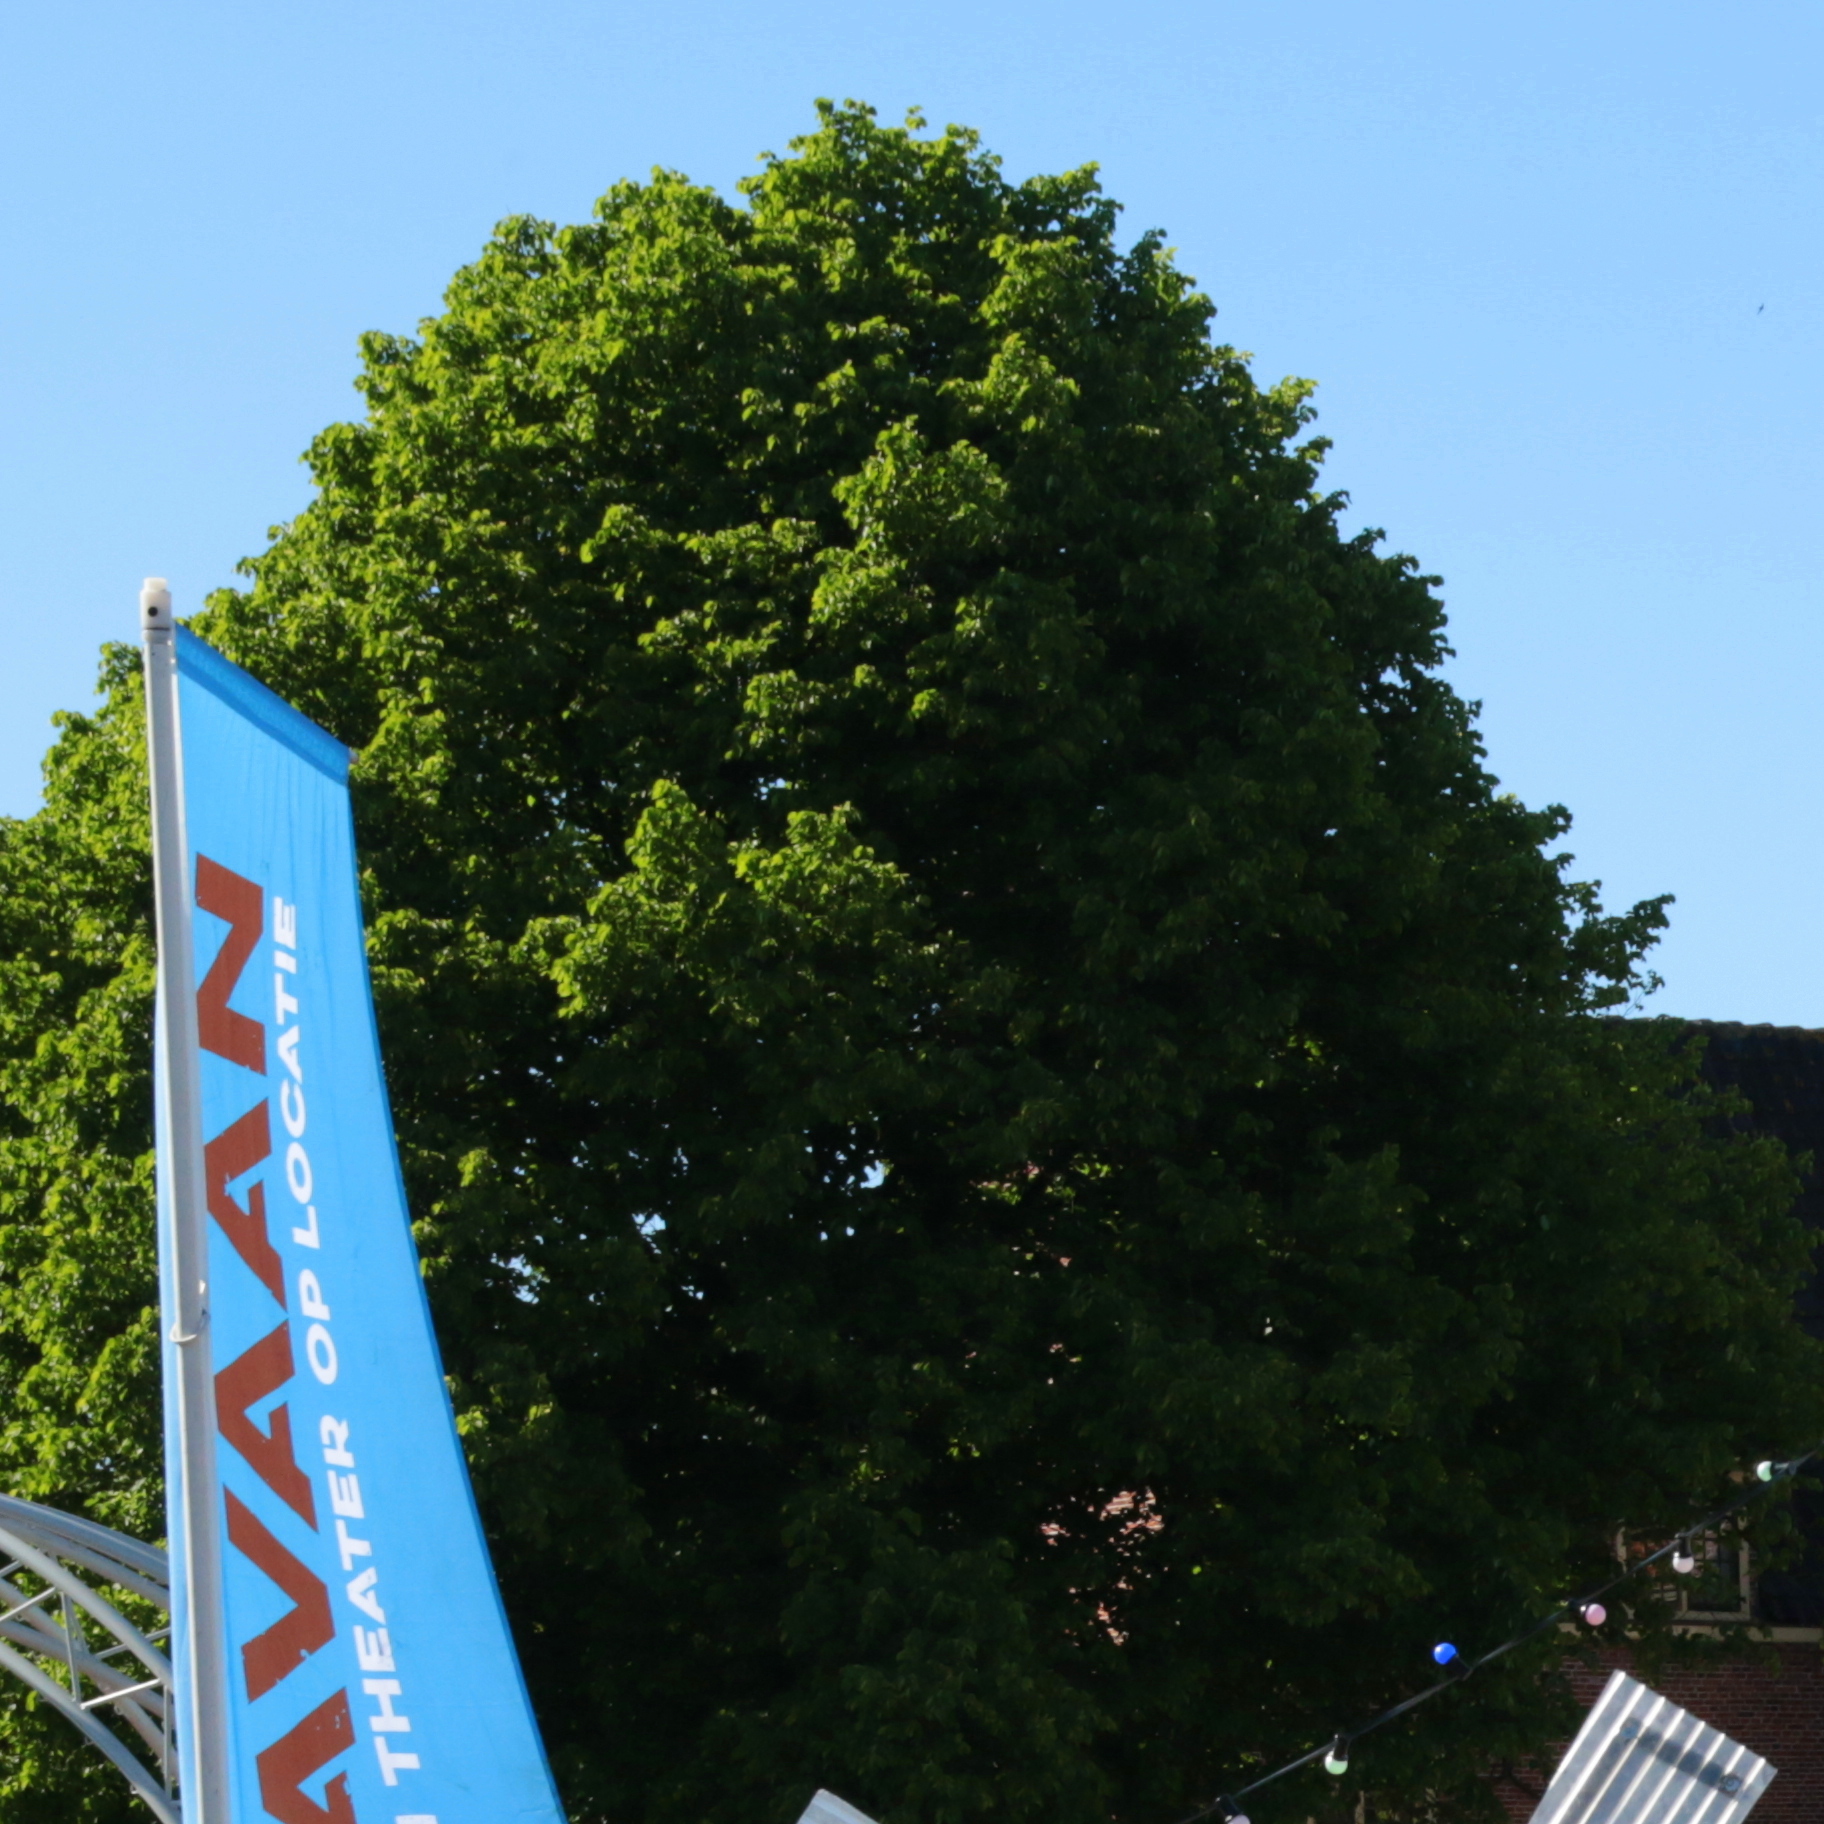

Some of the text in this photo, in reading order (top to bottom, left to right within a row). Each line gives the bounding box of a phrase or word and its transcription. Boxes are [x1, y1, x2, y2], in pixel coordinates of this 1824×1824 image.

[272, 896, 321, 1250] LOCATIE
[299, 1268, 340, 1386] OP
[320, 1414, 421, 1787] THEATER
